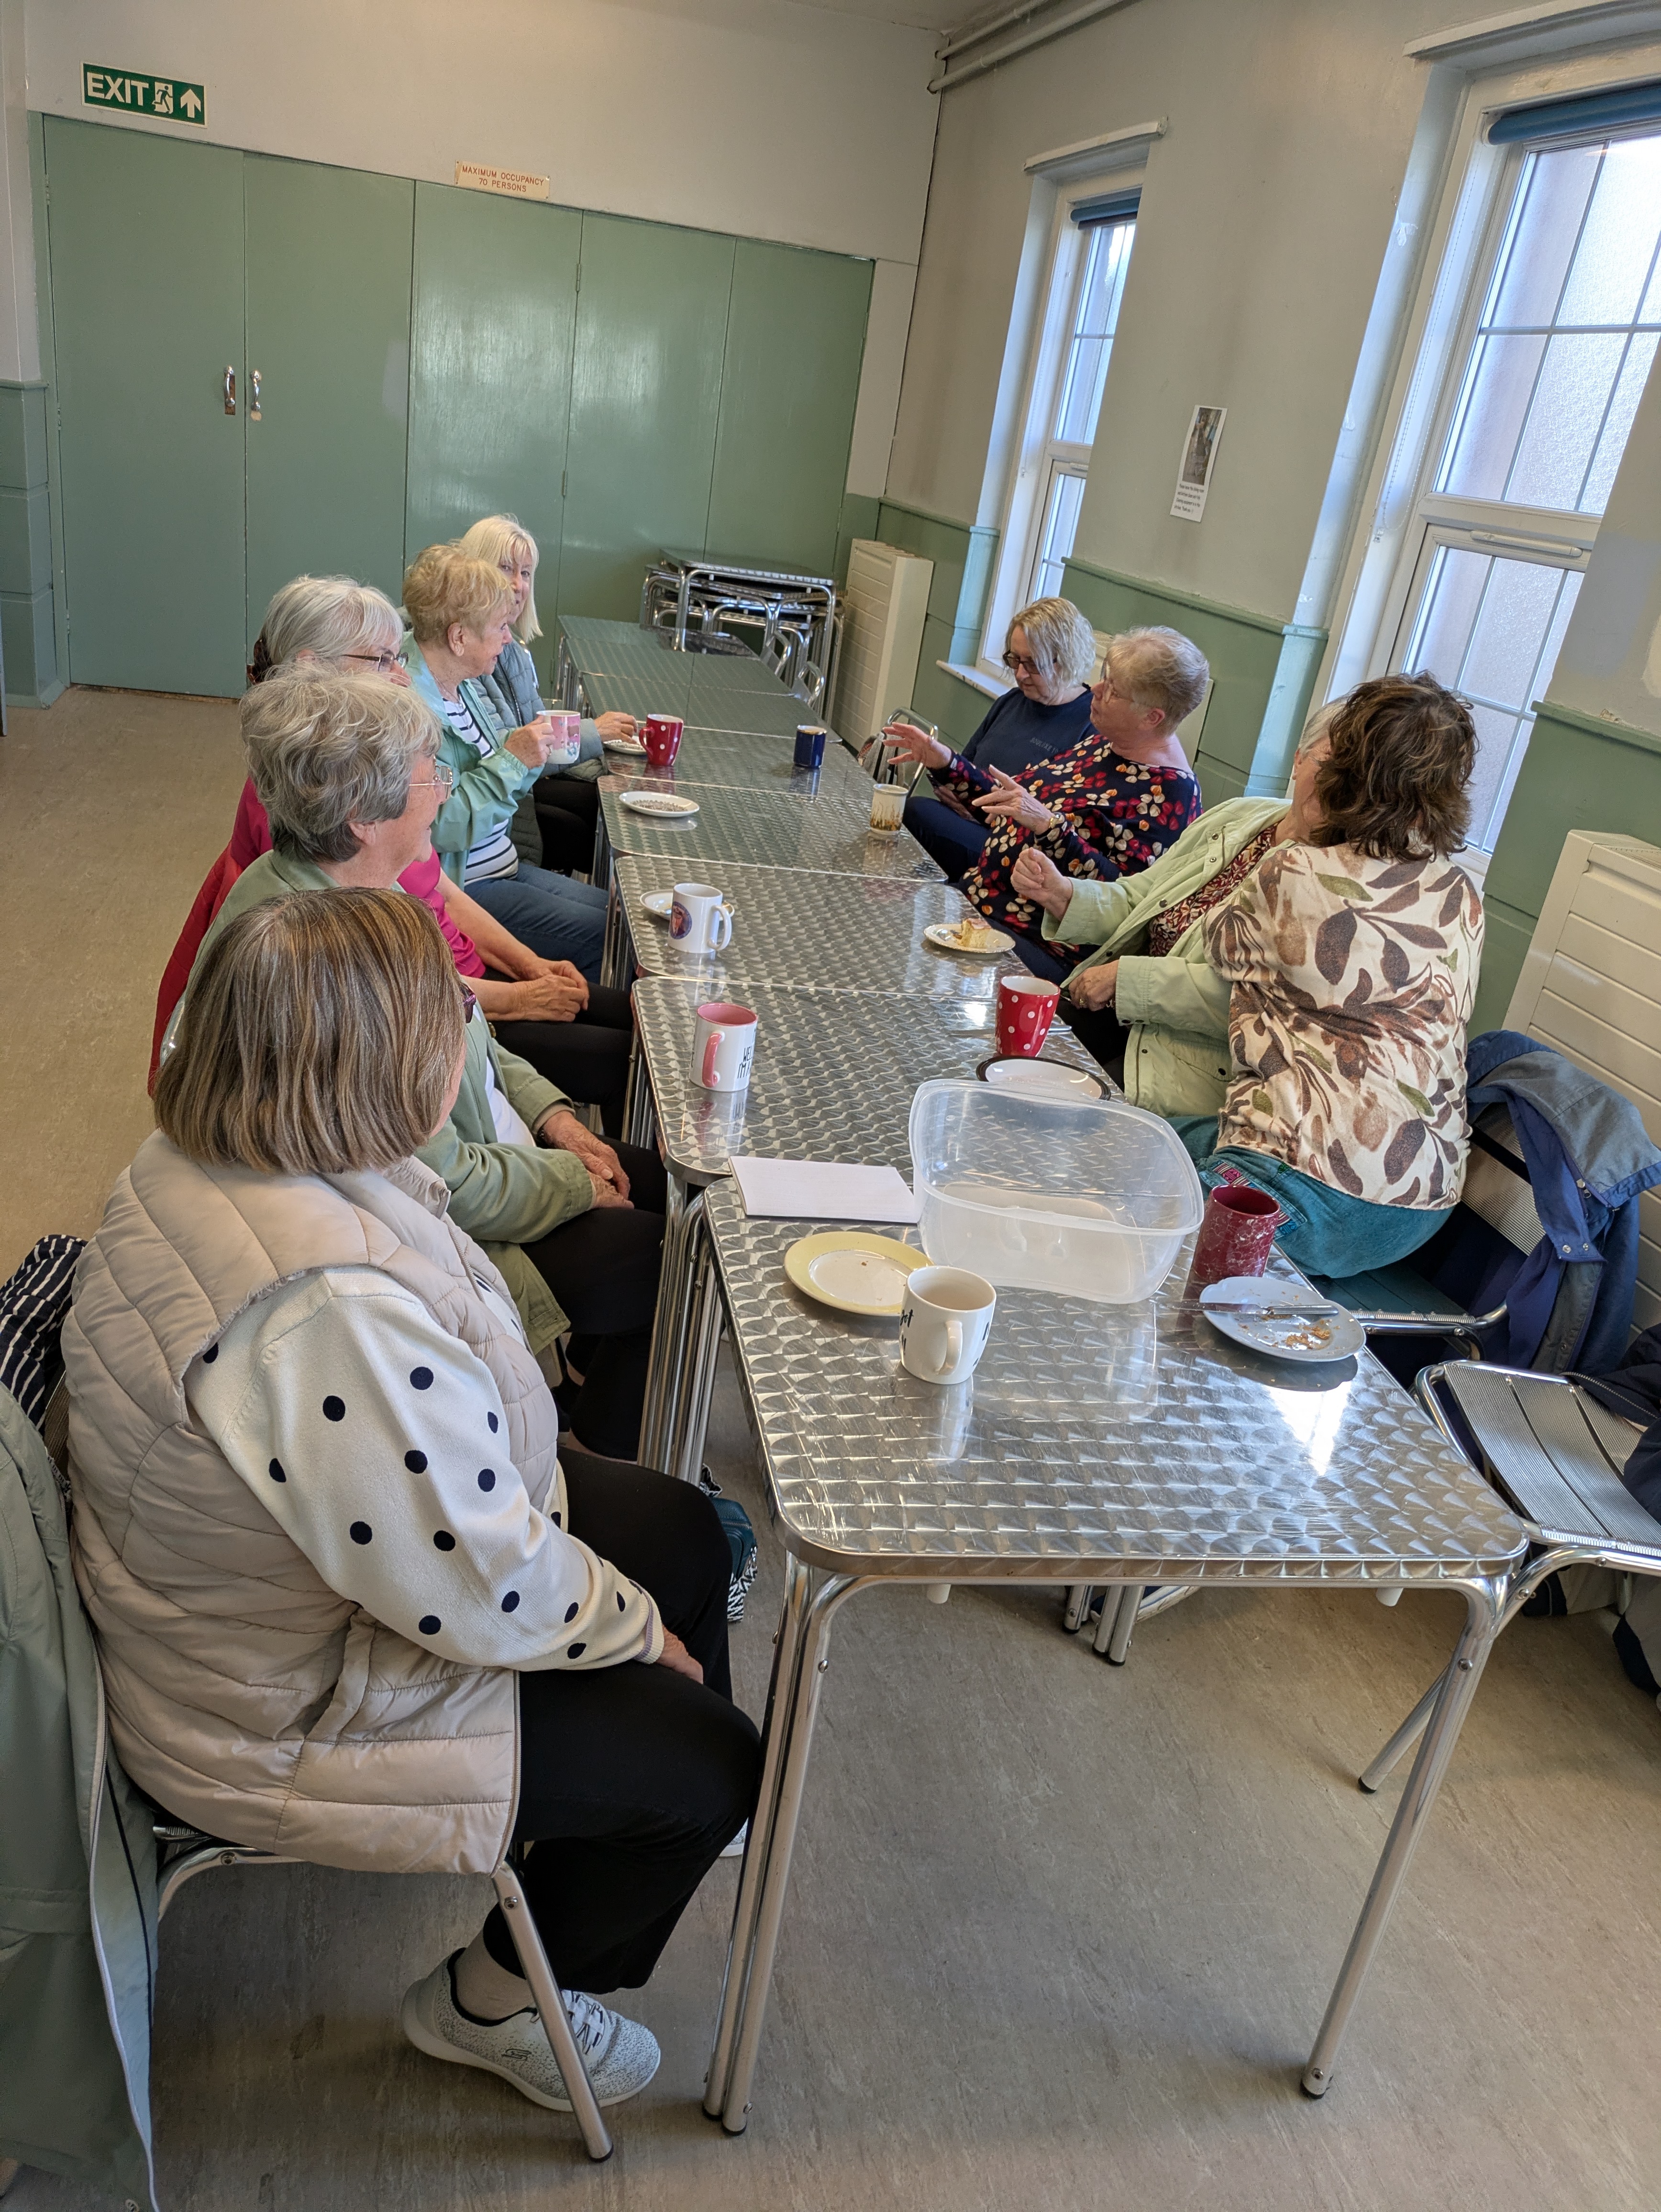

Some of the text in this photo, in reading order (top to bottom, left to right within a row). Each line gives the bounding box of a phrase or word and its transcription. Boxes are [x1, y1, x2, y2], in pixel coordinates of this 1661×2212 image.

[87, 72, 149, 106] EXIT
[462, 166, 544, 186] MAXIMUM OCCUPANCY
[492, 180, 526, 192] PERSONS
